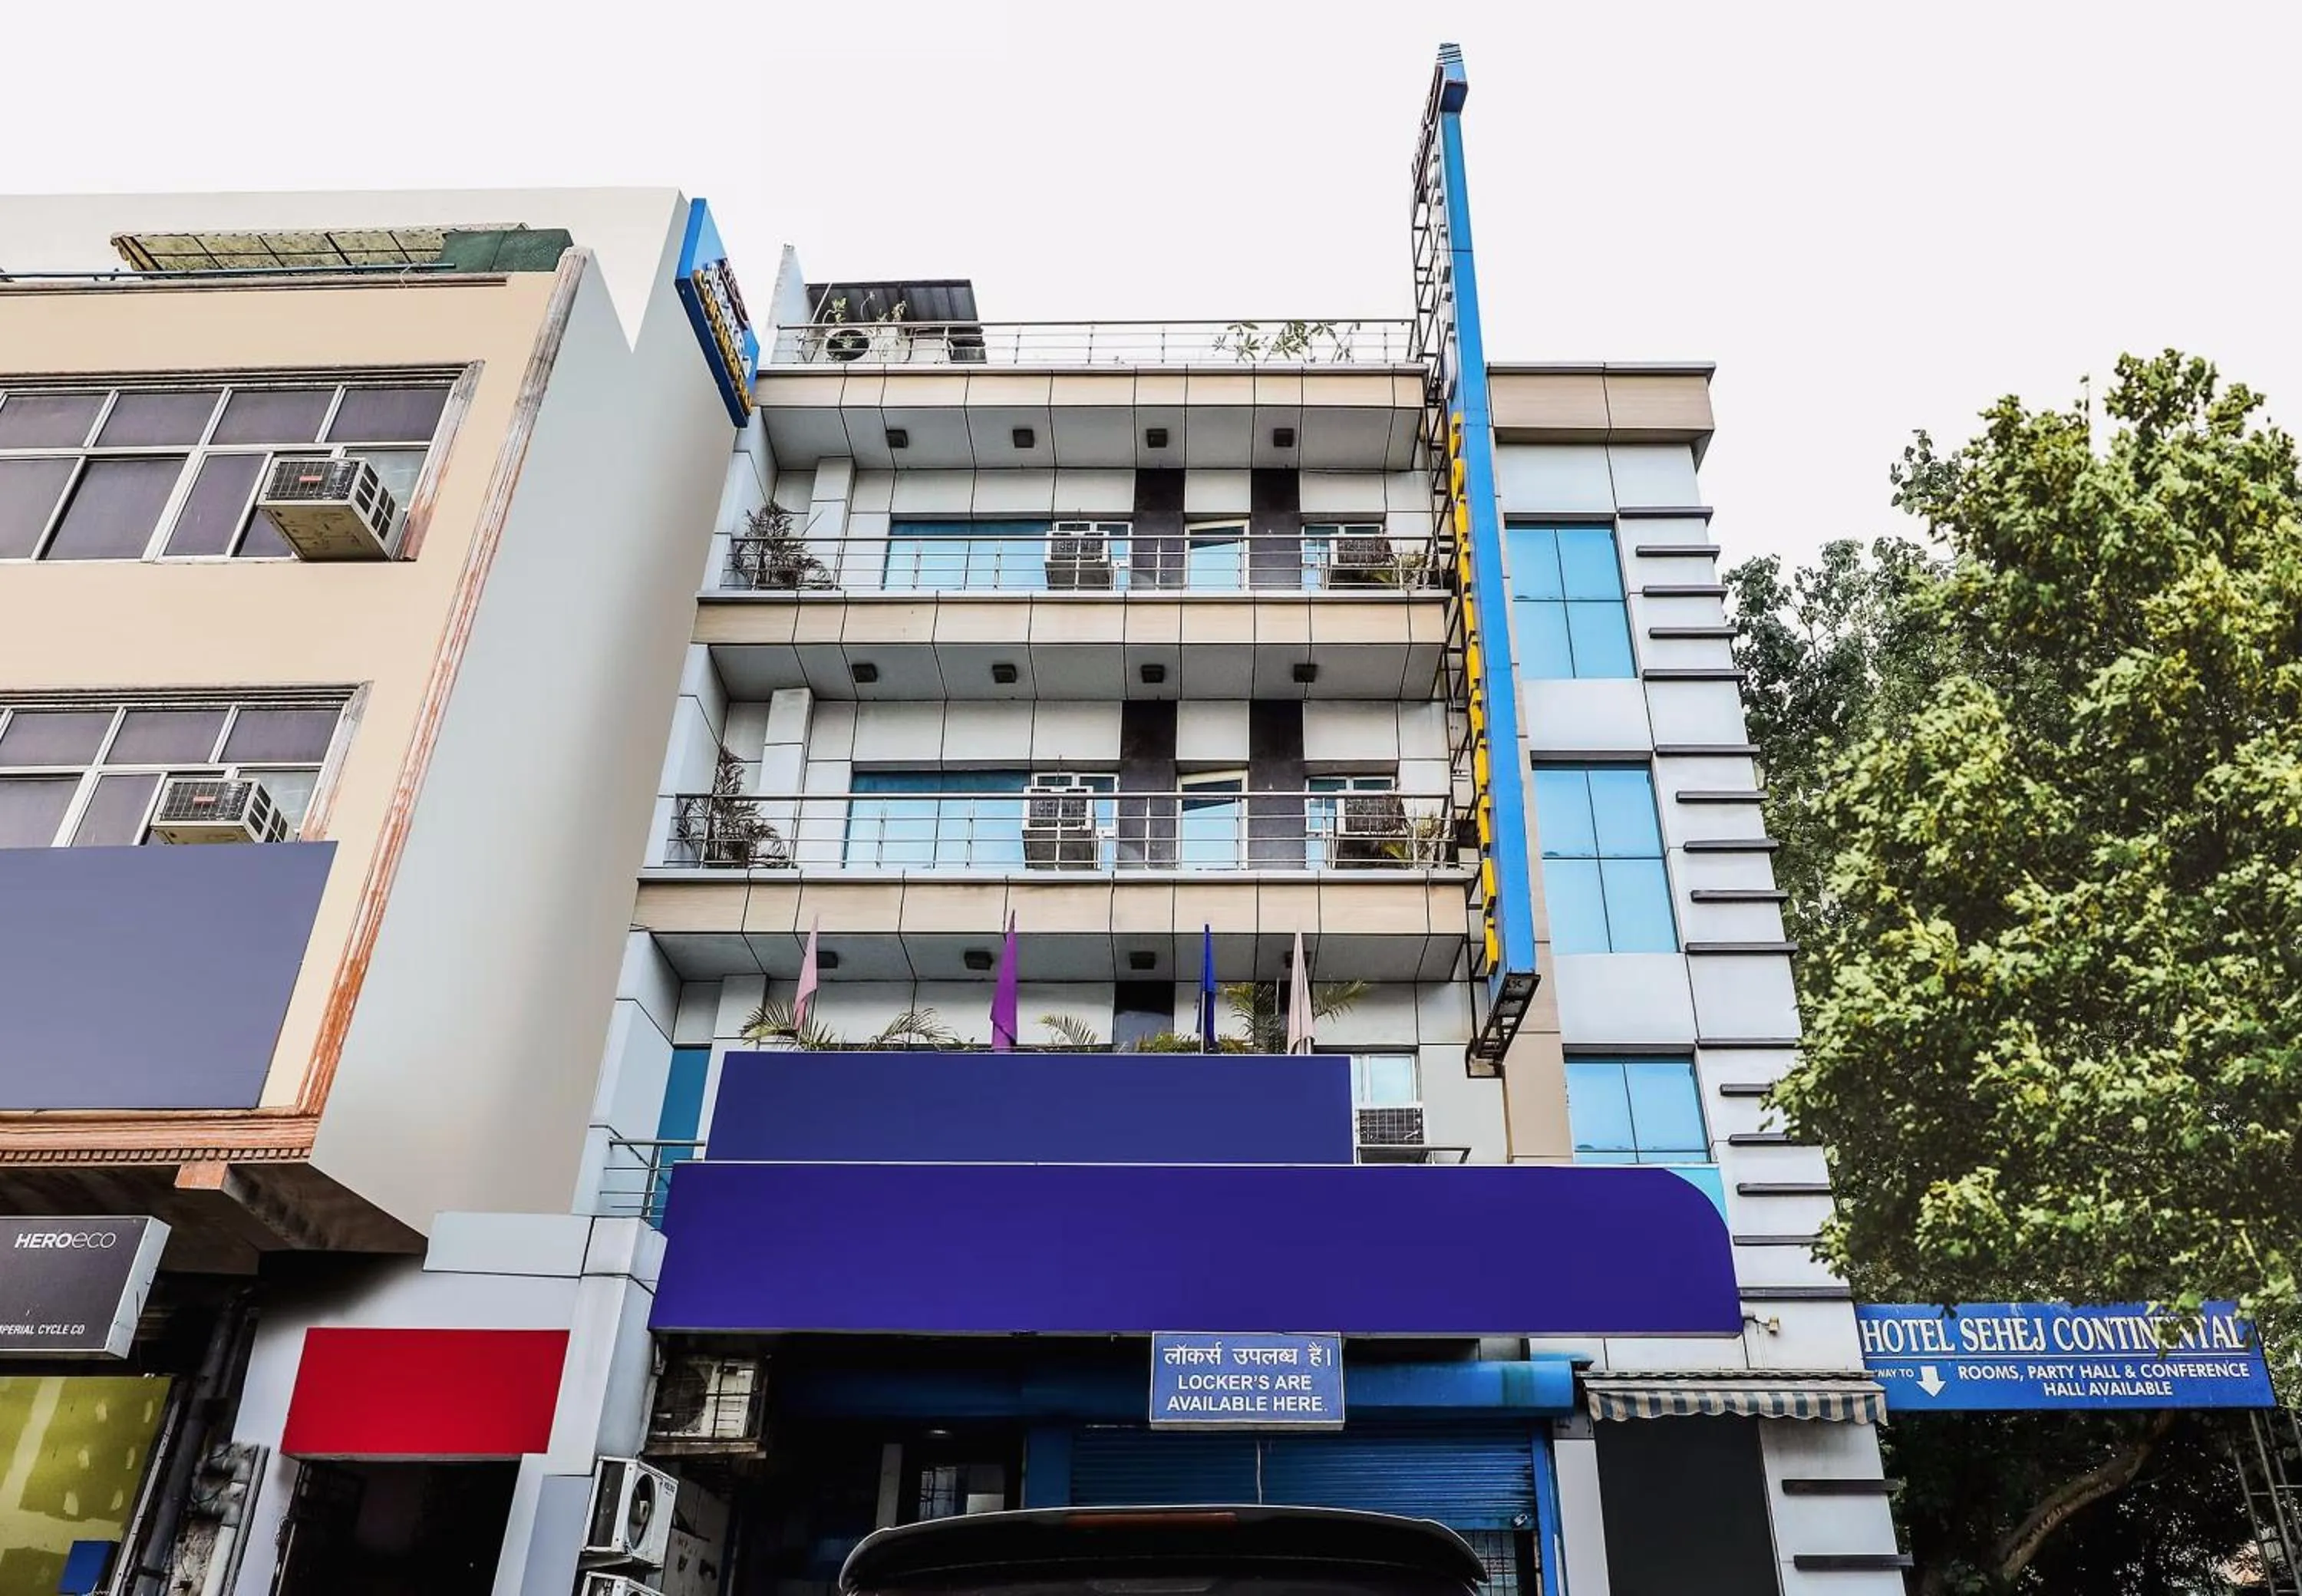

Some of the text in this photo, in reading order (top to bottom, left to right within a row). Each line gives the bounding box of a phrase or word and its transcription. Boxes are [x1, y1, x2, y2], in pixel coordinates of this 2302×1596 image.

[38, 1324, 70, 1334] CYCLE
[70, 1324, 85, 1334] CO
[1859, 1318, 1956, 1353] HOTEL
[1960, 1317, 2046, 1353] SEHEJ
[1163, 1341, 1222, 1365] लॉकर्स
[1232, 1348, 1298, 1365] उपलब्ध
[1898, 1368, 1914, 1378] TO
[1958, 1363, 2250, 1381] ROOMS, PARTY HALL & CONFERENCE
[1178, 1374, 1313, 1390] LOCKER'S ARE
[2044, 1380, 2173, 1396] HALL AVAILABLE
[1166, 1396, 1328, 1412] AVAILABLE HERE.
